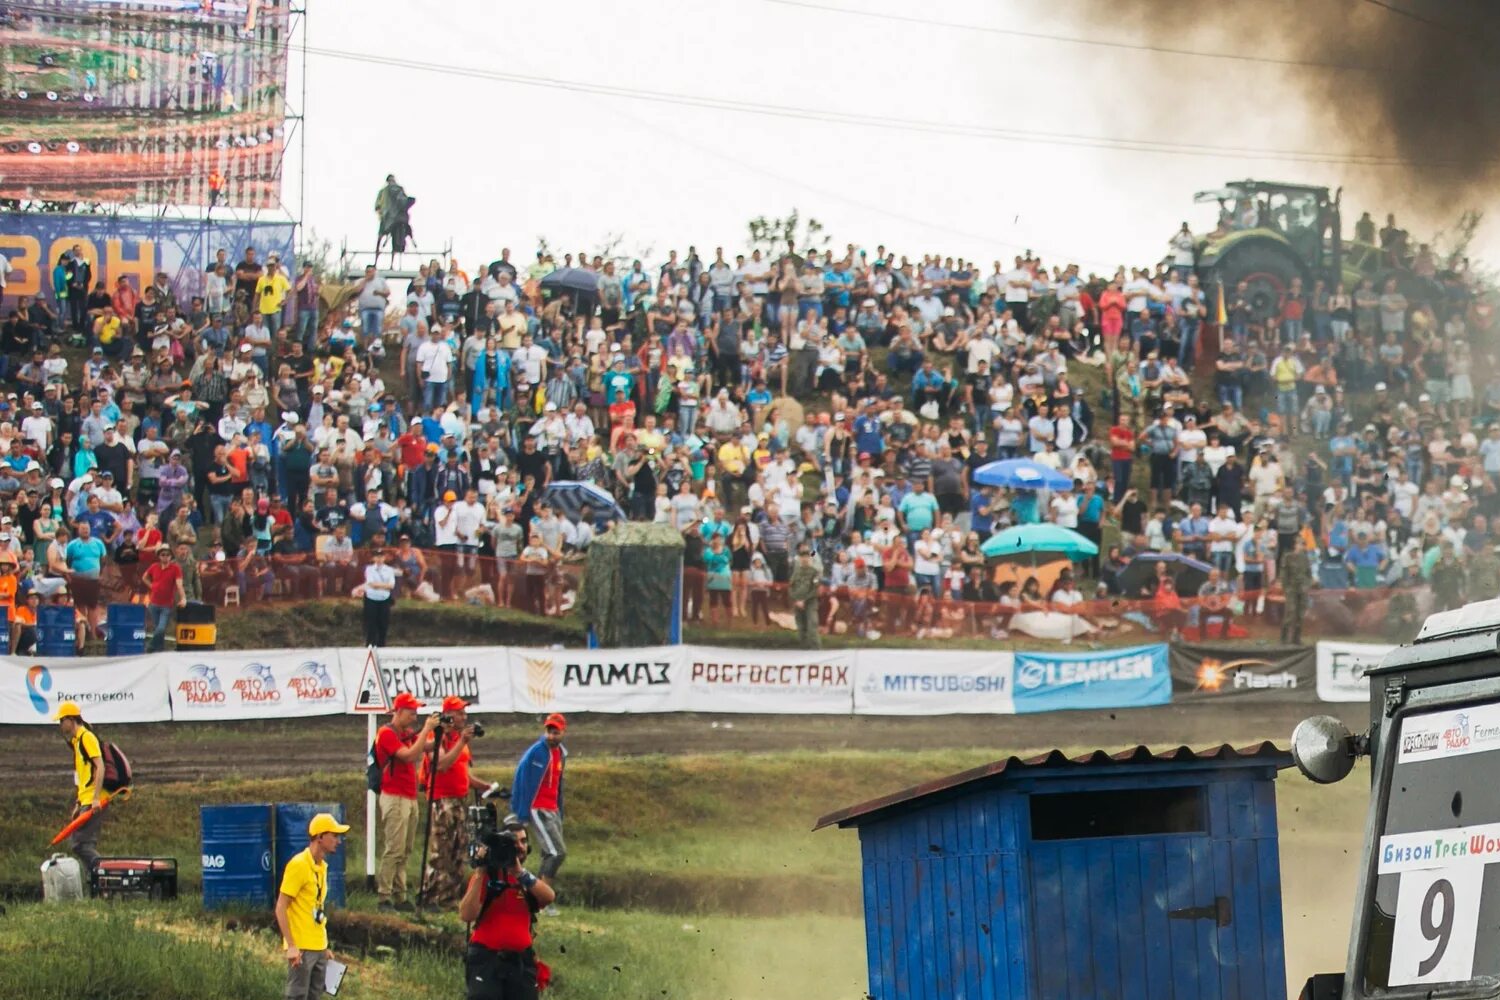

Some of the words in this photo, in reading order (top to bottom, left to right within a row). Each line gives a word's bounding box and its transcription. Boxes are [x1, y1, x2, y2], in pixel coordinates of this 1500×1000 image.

[563, 662, 671, 686] АЛМАЗ
[691, 662, 848, 686] РОСГОССТРАХ
[1046, 655, 1153, 686] LEMKEN
[177, 680, 208, 691] АВТО
[231, 679, 262, 690] АВТО
[288, 677, 317, 688] АВТО
[381, 665, 480, 698] РЕСТЬЯНИН
[883, 675, 1005, 692] MITSUBOSHI
[57, 691, 134, 702] Ростелеком
[186, 690, 226, 702] РАДИО
[241, 689, 281, 701] РАДИО
[297, 687, 336, 699] РАДИО
[1446, 736, 1471, 749] РАДИО
[1417, 878, 1455, 977] 9
